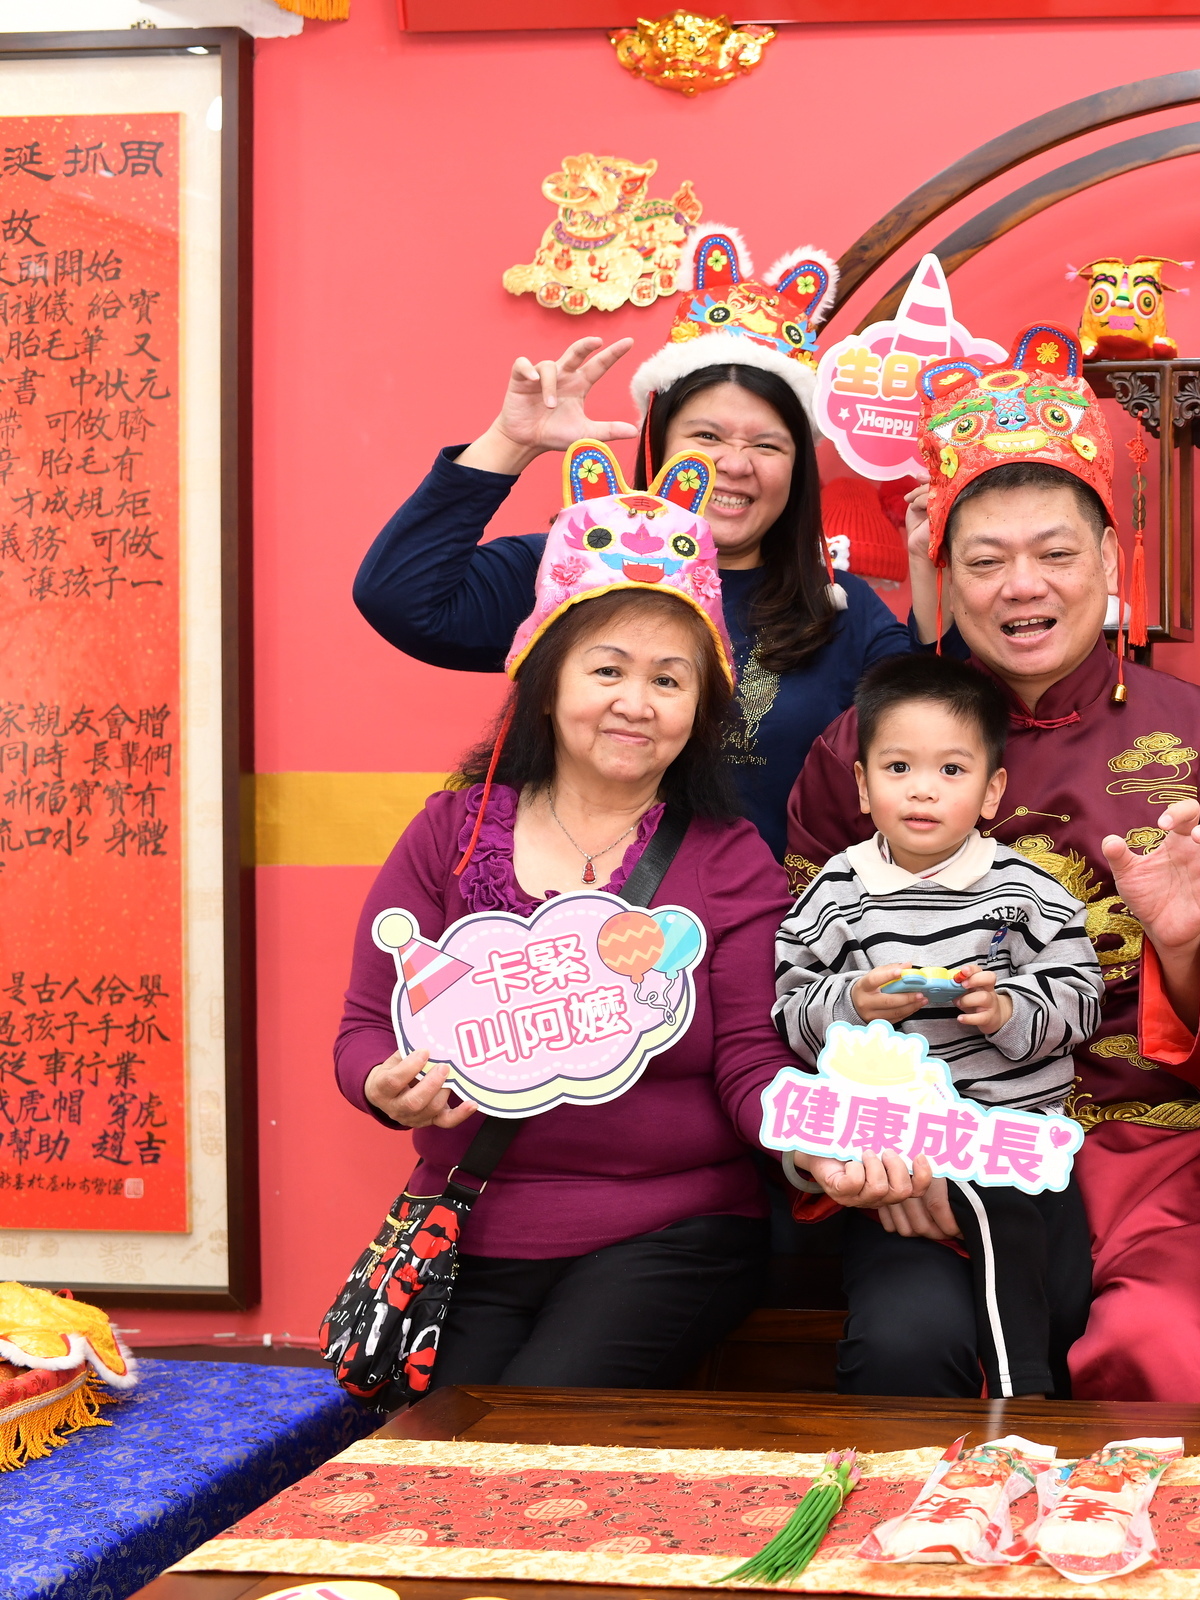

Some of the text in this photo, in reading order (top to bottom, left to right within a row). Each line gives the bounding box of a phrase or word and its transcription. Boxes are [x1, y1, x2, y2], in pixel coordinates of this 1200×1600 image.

[0, 140, 165, 182] 涎抓周
[2, 209, 47, 248] 故
[0, 325, 162, 364] 胎毛筆 又
[0, 366, 46, 405] 書
[833, 346, 942, 399] 生日
[863, 410, 914, 437] Happy
[11, 485, 153, 521] 才成規矩
[90, 526, 164, 564] 可做
[83, 740, 172, 779] 長輩們
[104, 818, 169, 857] 身體
[472, 933, 591, 1004] 卡緊
[0, 1126, 71, 1167] 幫助
[771, 1079, 1044, 1184] 健康成長
